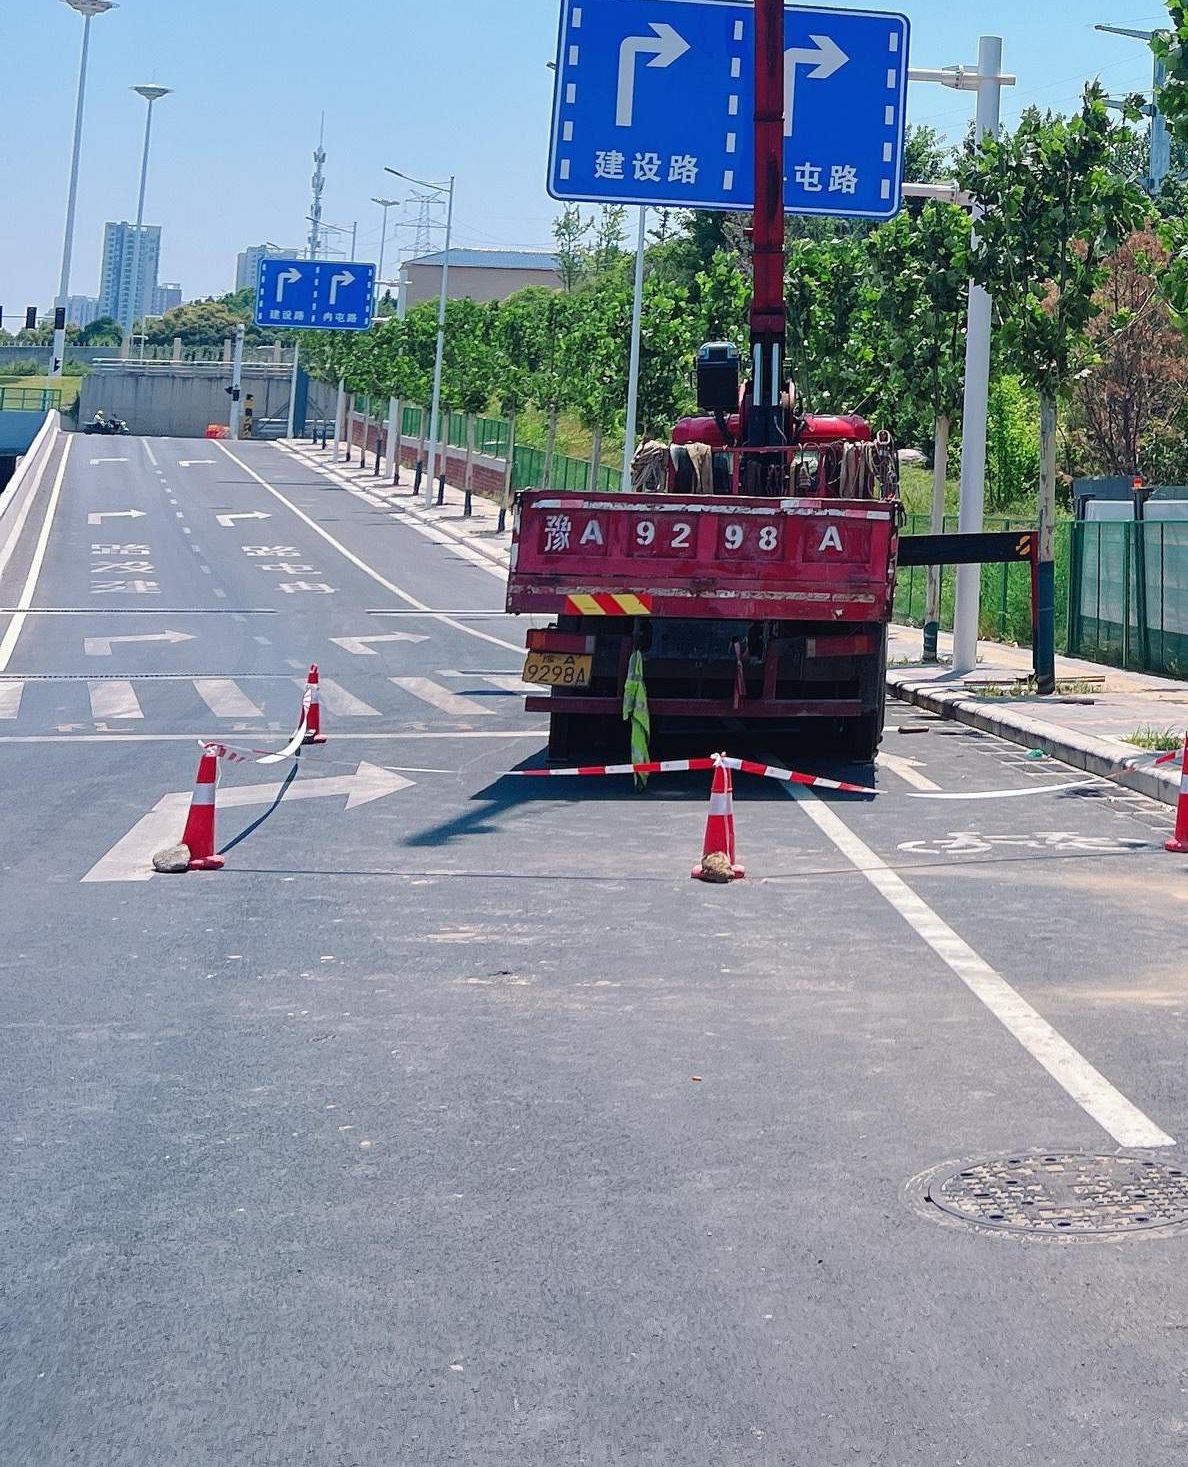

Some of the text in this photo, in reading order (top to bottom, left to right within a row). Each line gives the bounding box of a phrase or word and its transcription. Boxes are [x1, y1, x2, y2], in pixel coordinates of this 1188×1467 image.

[594, 150, 699, 184] 建设路
[783, 162, 859, 194] 屯路
[269, 309, 305, 321] 建设路
[528, 664, 586, 684] 9298A
